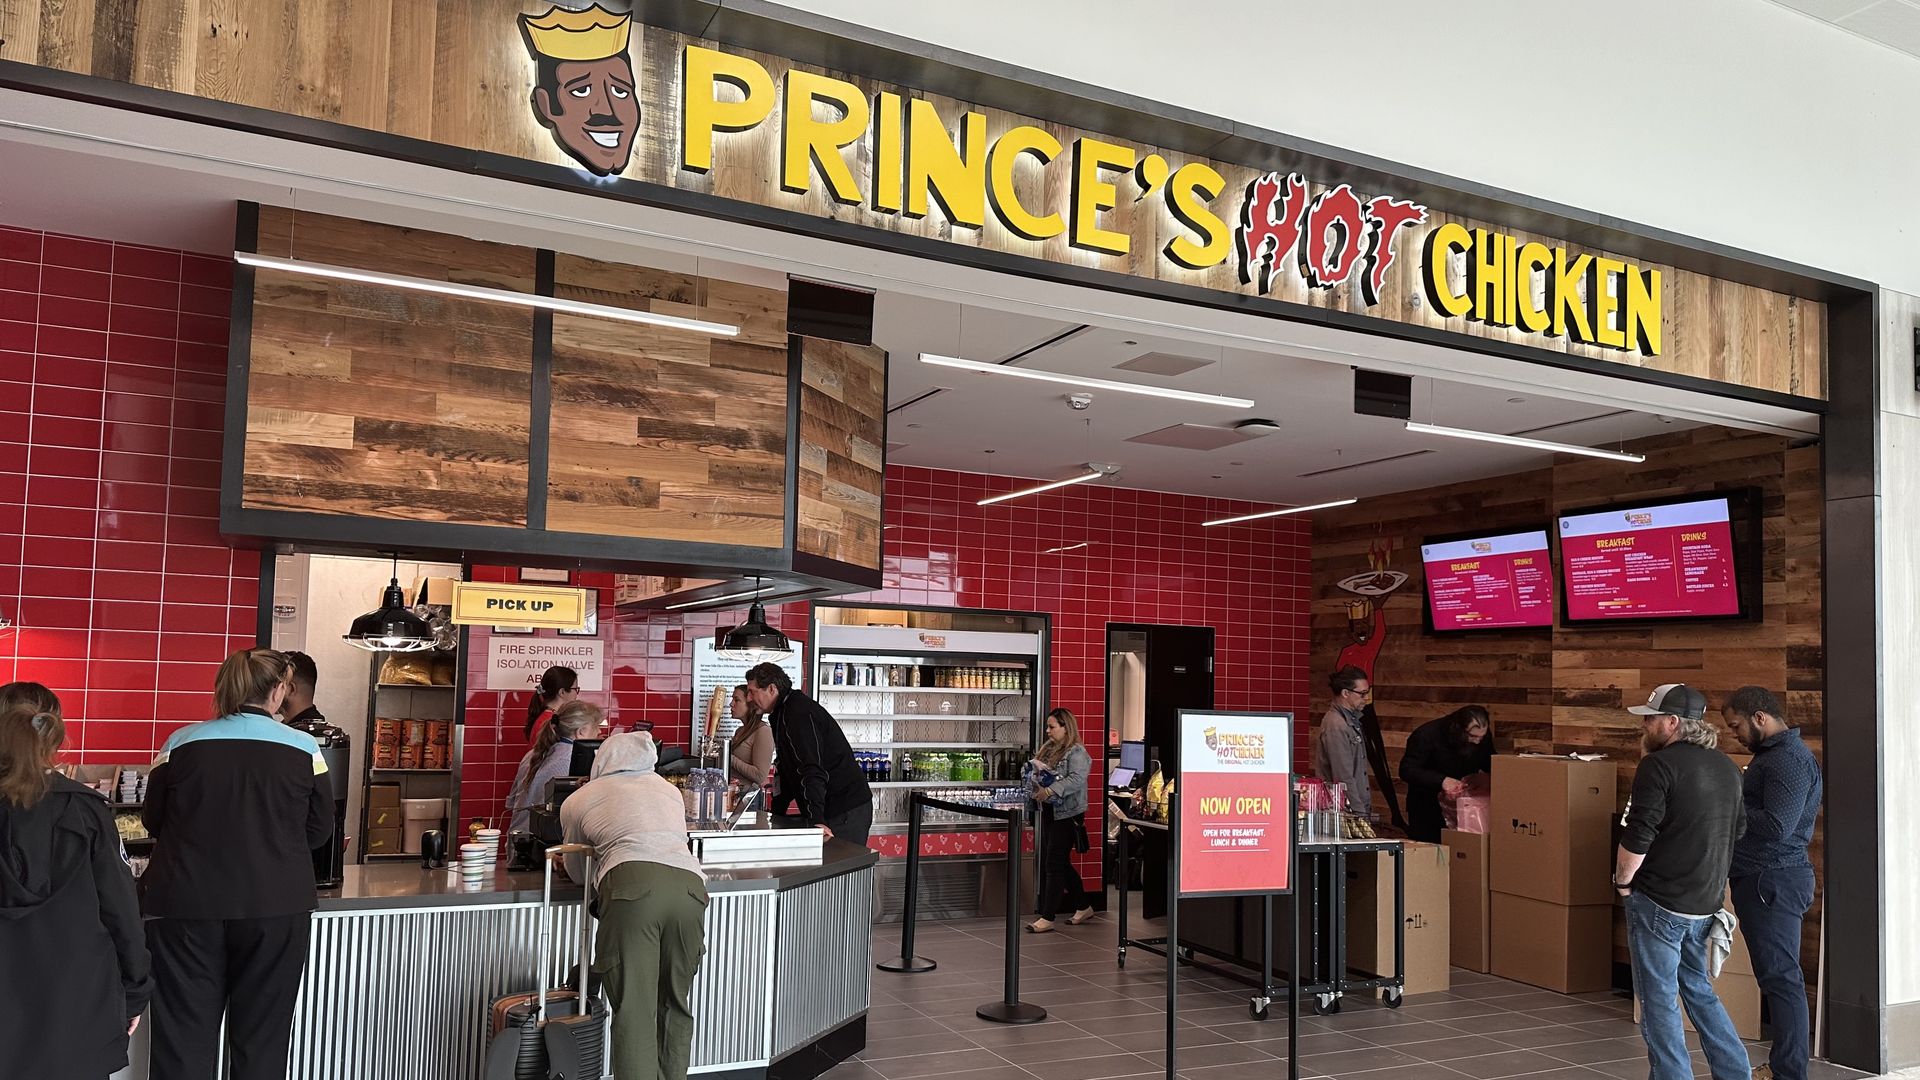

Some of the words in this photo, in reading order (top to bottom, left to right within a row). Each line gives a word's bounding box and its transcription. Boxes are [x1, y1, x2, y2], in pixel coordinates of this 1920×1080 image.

[681, 45, 1231, 269] PRINCE'S
[1238, 172, 1428, 305] HOT
[1423, 222, 1662, 356] CHICKEN
[1596, 537, 1635, 549] BREAKFAST
[1681, 532, 1707, 542] DRINKS
[486, 598, 526, 611] PICK
[531, 601, 554, 612] UP
[499, 644, 525, 655] FIRE
[529, 645, 593, 656] SPRINKLER
[497, 659, 558, 670] ISOLATION
[561, 661, 594, 670] VALVE
[1218, 733, 1264, 746] PRINCE'S
[1200, 796, 1231, 815] NOW
[1236, 797, 1271, 815] OPEN
[1203, 828, 1218, 837] OPEN
[1219, 828, 1230, 837] FOR
[1232, 828, 1266, 837] BREAKFAST,
[1210, 838, 1229, 847] LUNCH
[1231, 838, 1236, 846] &
[1238, 838, 1258, 846] DINNER
